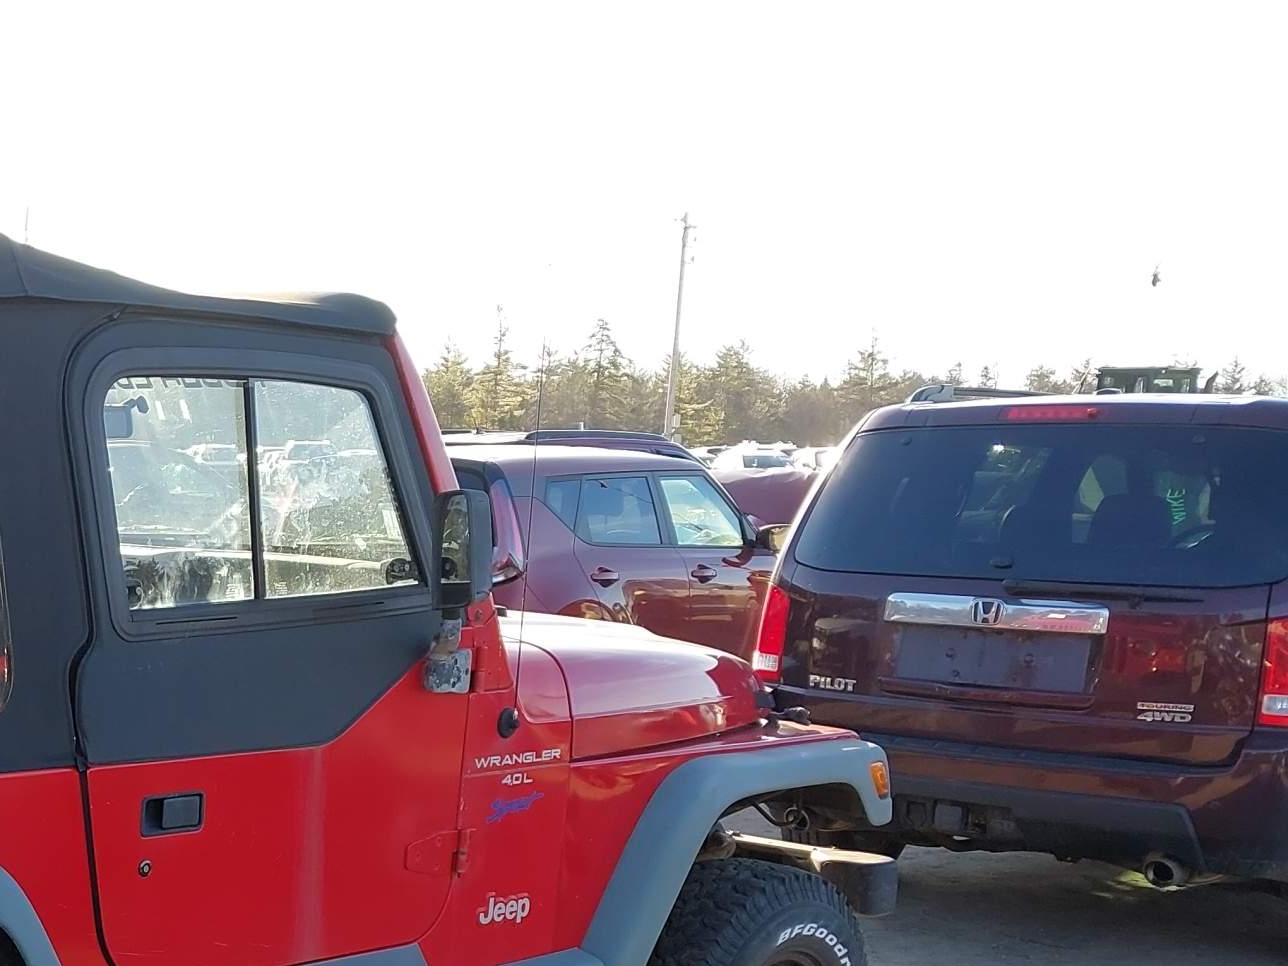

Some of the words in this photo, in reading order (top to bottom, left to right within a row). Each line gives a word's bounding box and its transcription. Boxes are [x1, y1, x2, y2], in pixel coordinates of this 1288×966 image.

[808, 674, 857, 692] PILOT
[1136, 710, 1193, 723] 4WD
[474, 748, 561, 769] WRANGLER
[478, 896, 531, 925] Jeep
